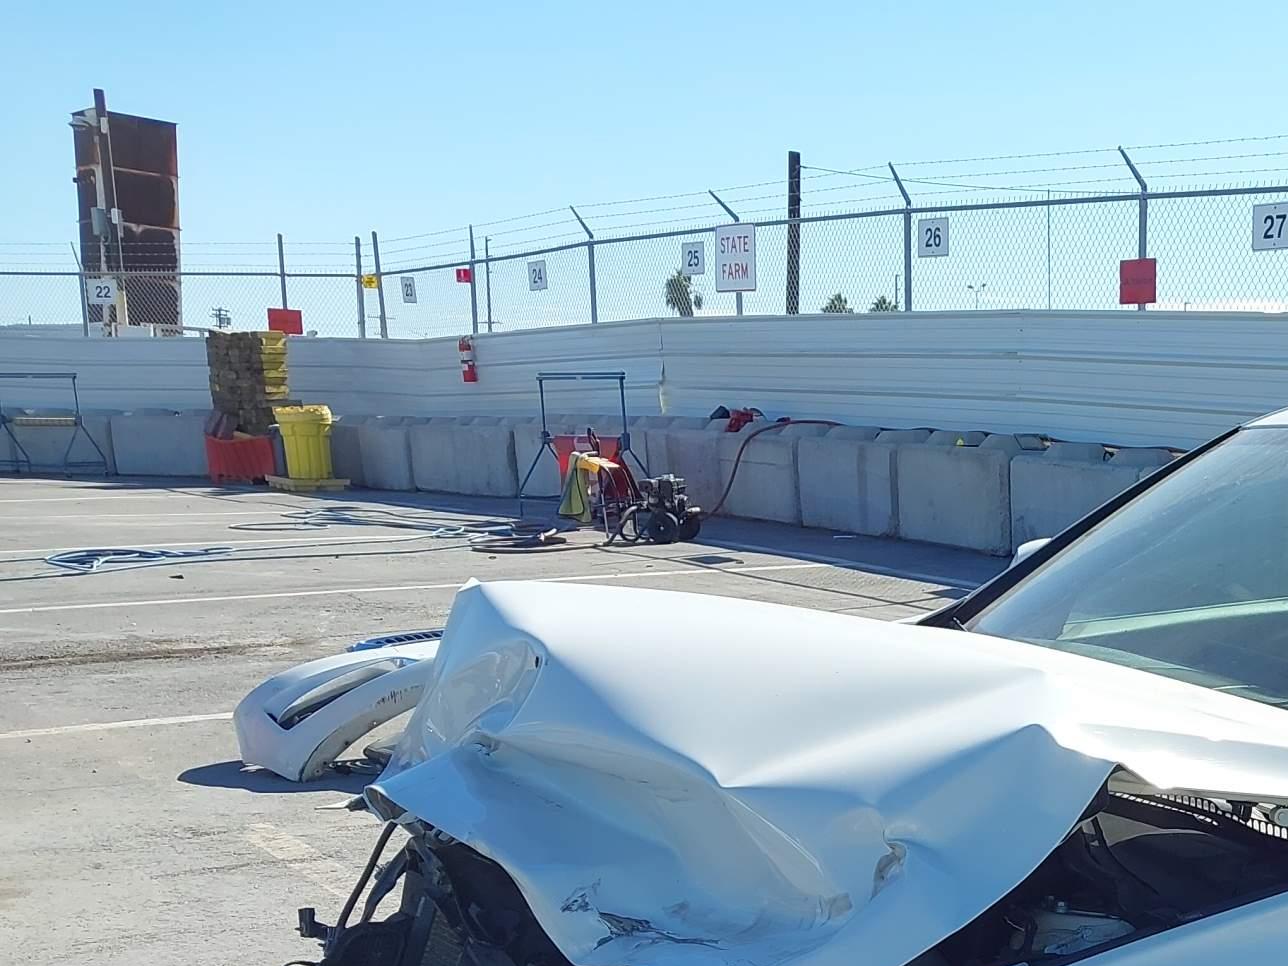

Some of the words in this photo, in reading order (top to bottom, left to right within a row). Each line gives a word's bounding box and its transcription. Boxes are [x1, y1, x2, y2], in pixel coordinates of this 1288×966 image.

[1263, 214, 1287, 239] 27
[720, 235, 749, 254] STATE
[925, 227, 941, 248] 26
[687, 250, 700, 267] 25
[532, 268, 543, 284] 24
[722, 262, 749, 280] FARM
[95, 285, 112, 298] 22
